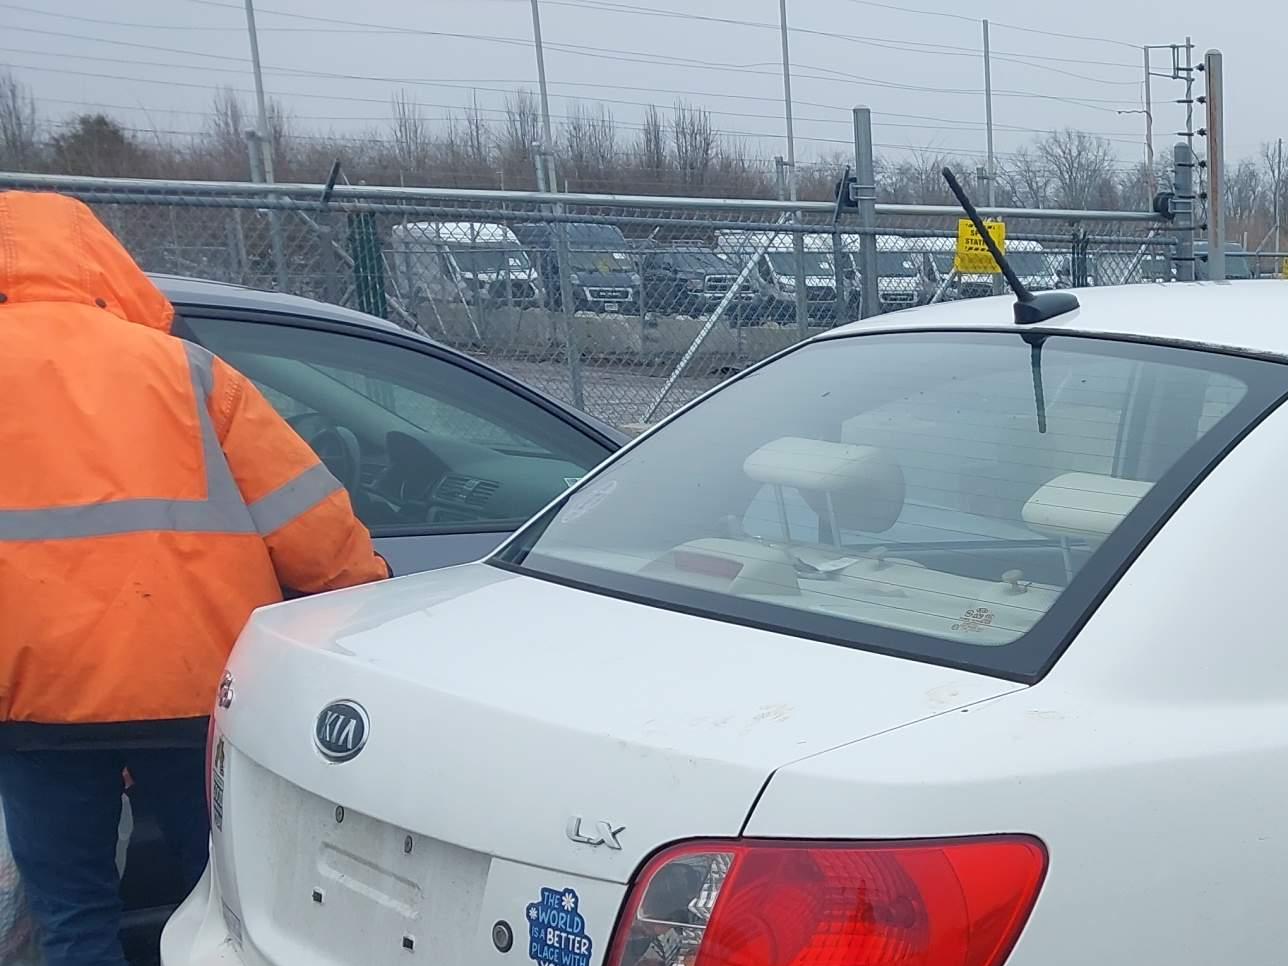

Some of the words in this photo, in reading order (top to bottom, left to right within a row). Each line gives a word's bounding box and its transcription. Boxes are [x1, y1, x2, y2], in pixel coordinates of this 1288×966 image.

[320, 710, 357, 750] KIA
[566, 816, 626, 850] LX
[543, 891, 560, 908] THE
[538, 906, 581, 933] WORLD
[532, 926, 539, 938] IS
[539, 930, 545, 940] A
[546, 928, 589, 955] BETTER
[532, 942, 559, 962] PLACE
